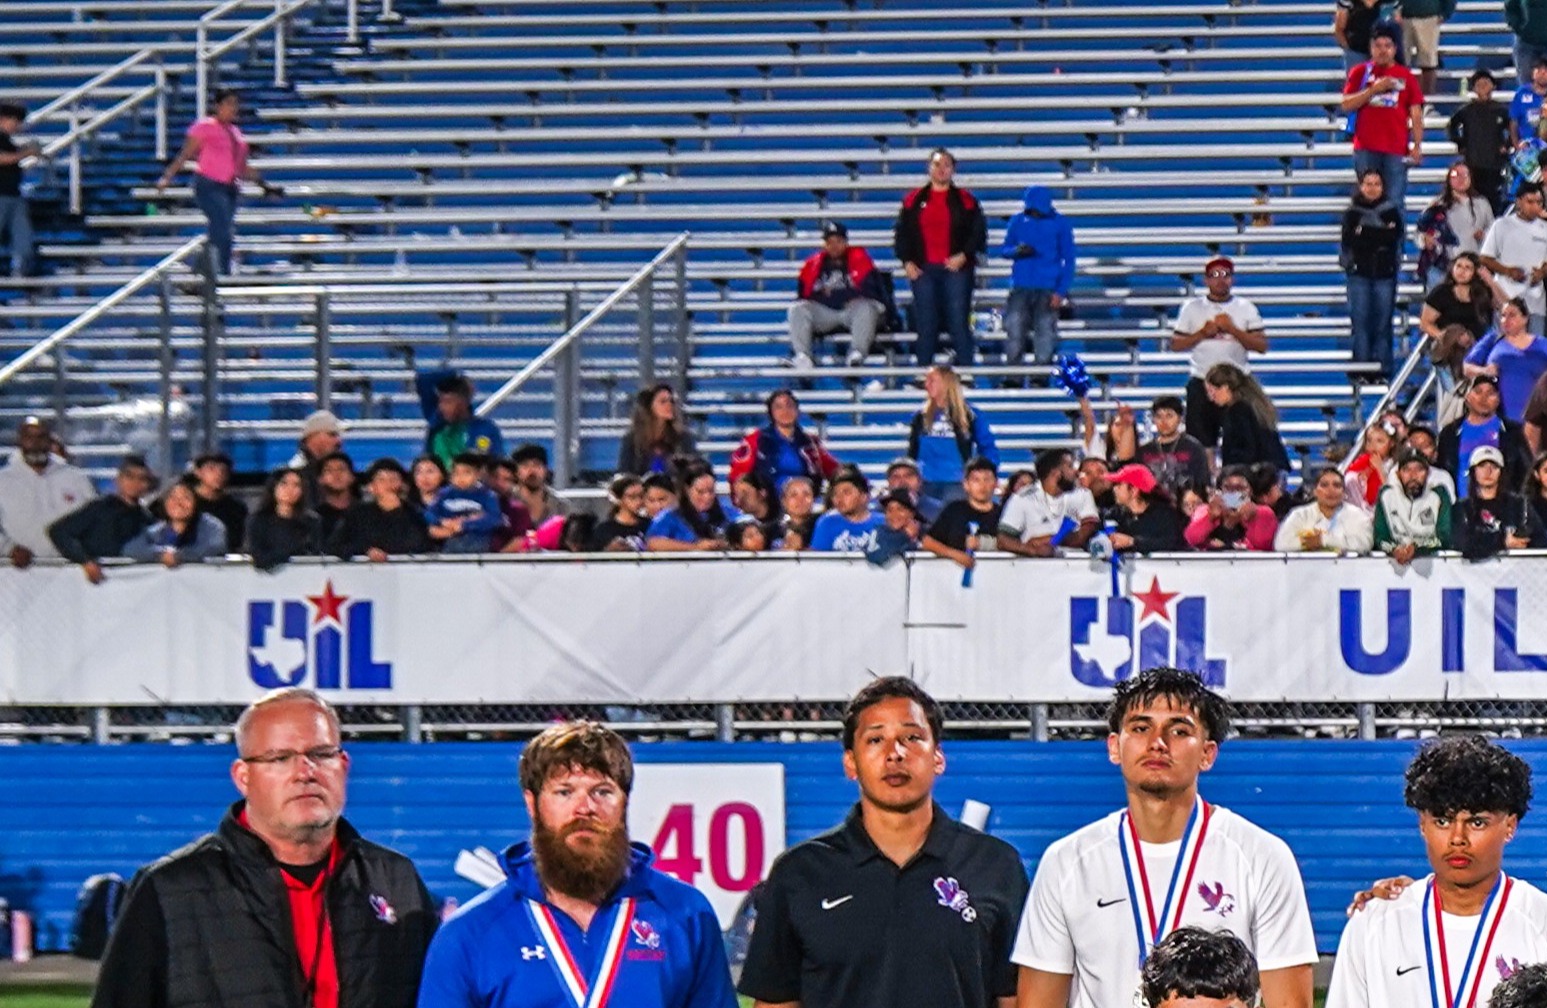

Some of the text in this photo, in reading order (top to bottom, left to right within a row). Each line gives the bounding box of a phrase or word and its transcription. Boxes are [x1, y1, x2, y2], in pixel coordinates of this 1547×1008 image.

[248, 601, 391, 689] UIL
[1070, 597, 1227, 687] UIL
[651, 801, 764, 893] 40
